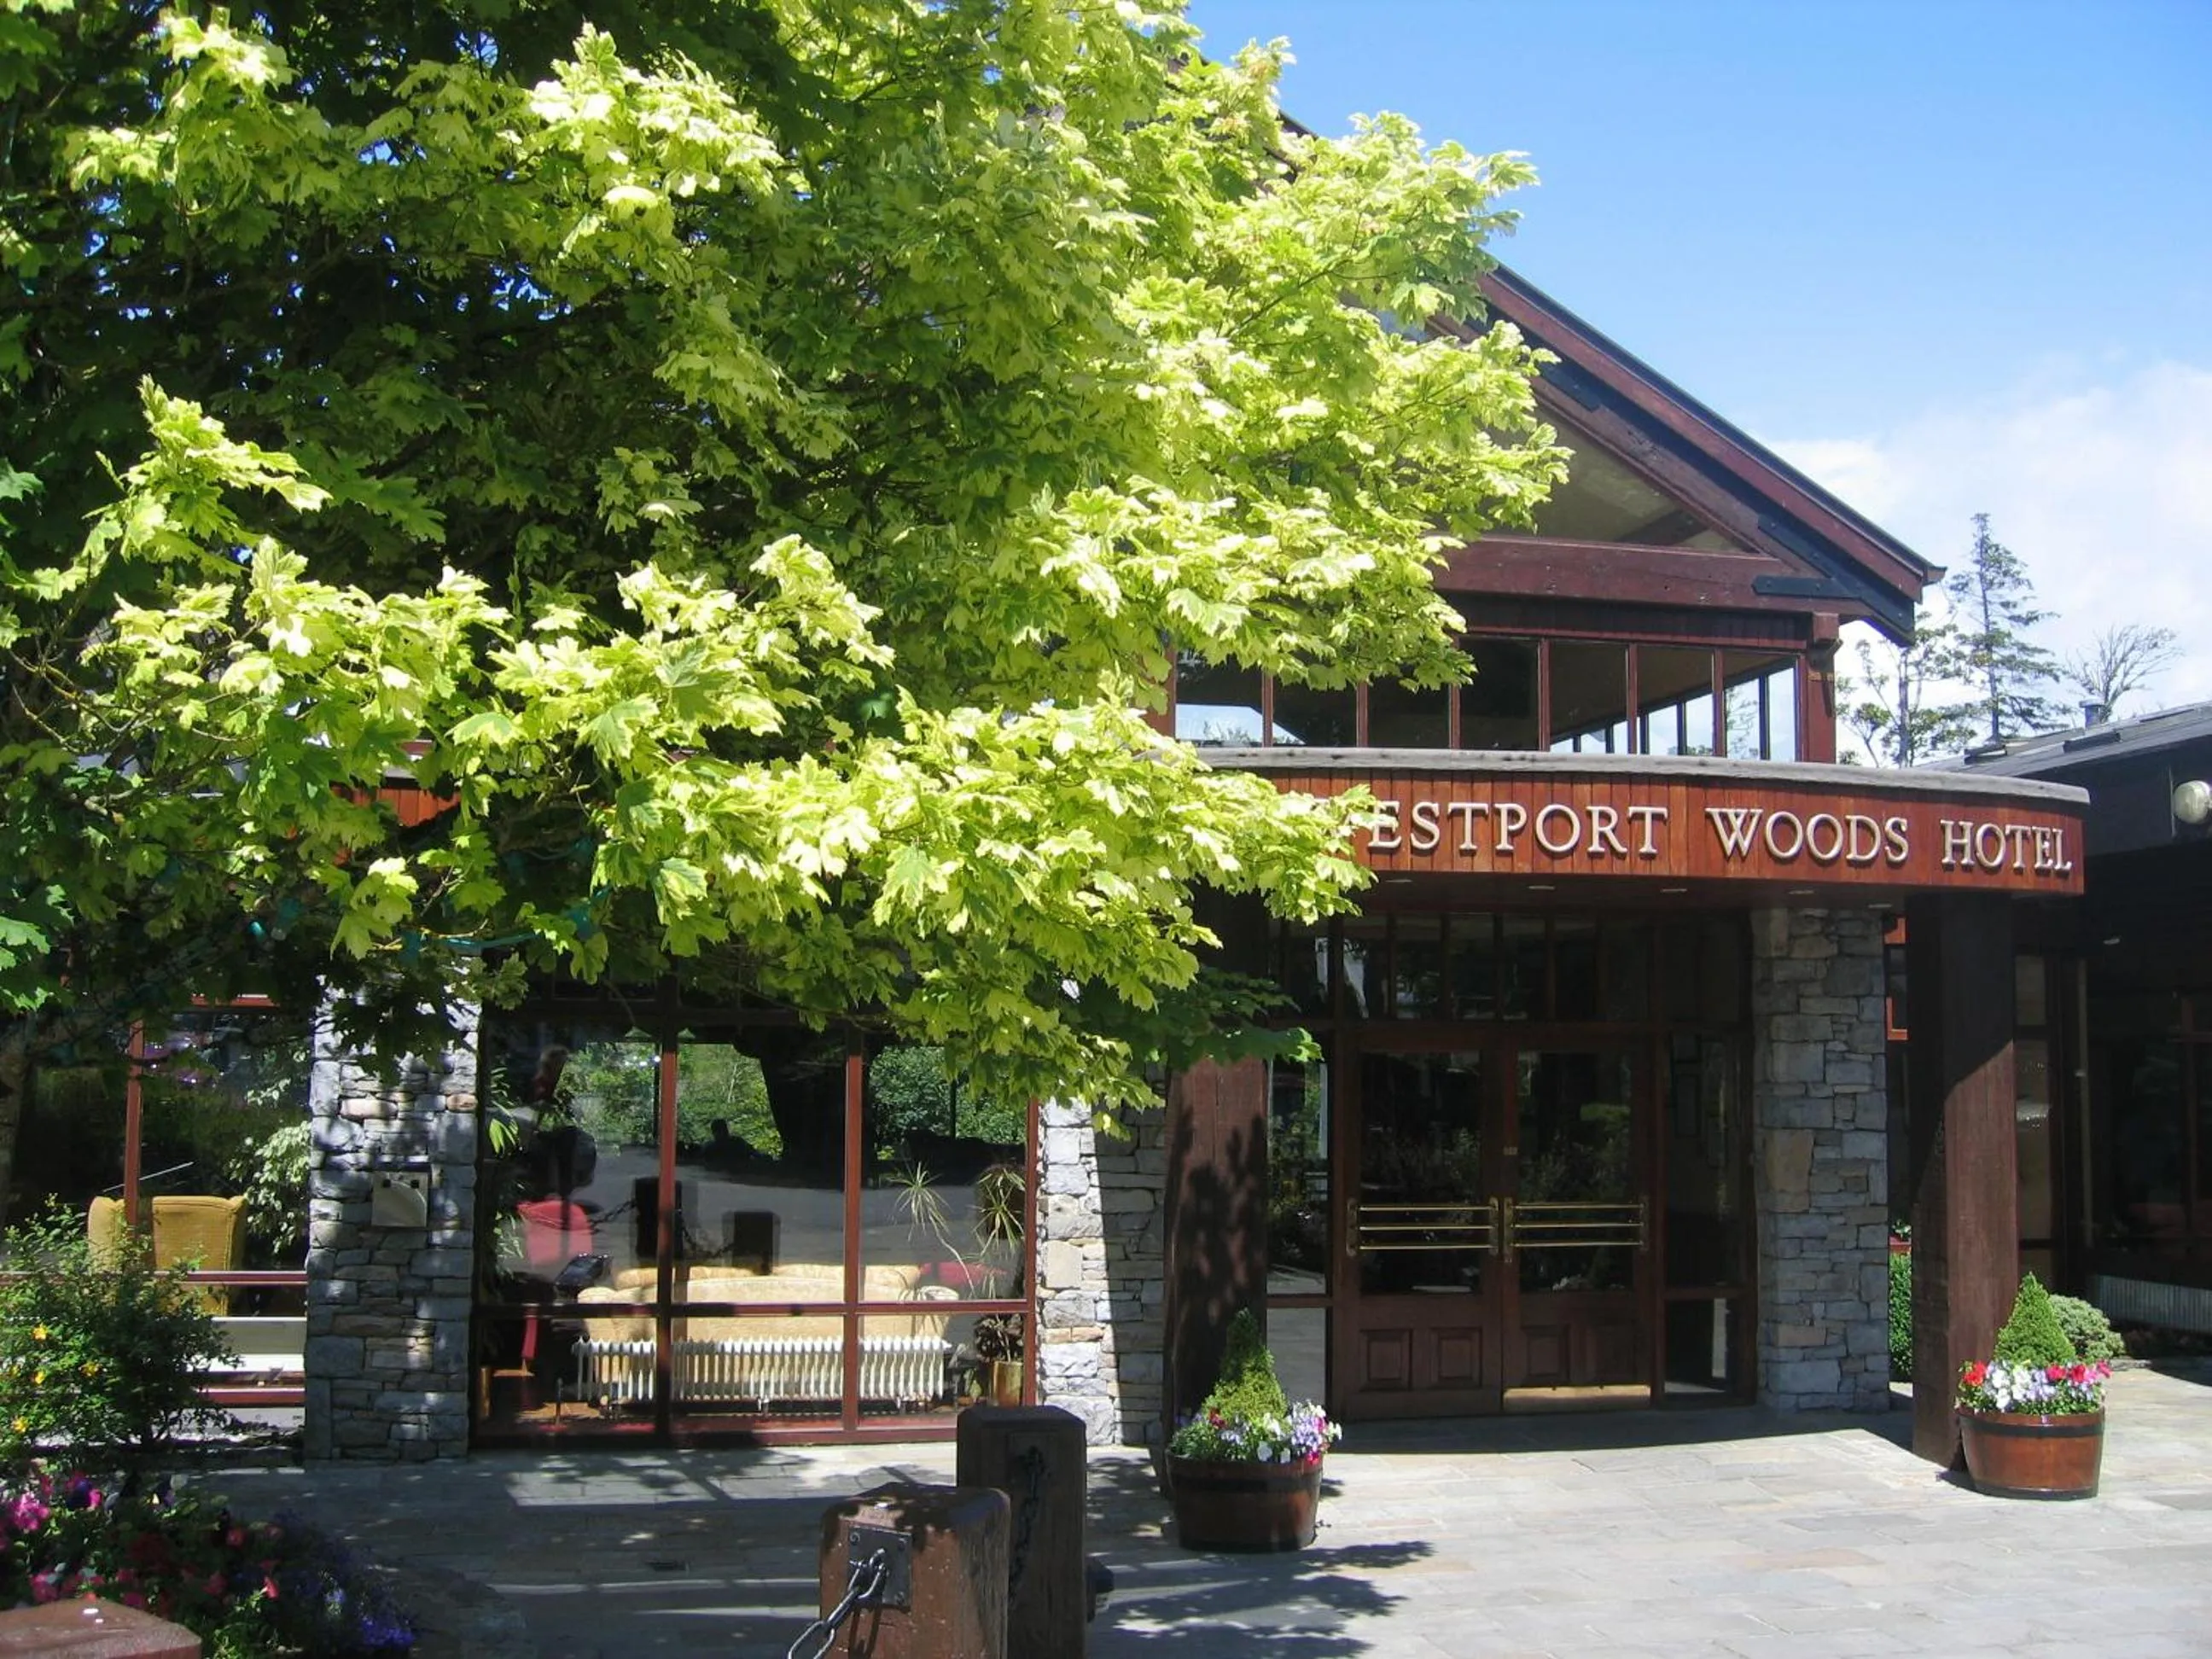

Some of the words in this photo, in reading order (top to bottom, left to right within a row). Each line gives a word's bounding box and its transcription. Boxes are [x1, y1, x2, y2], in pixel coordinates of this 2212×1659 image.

[1314, 799, 1668, 854] ESTPORT
[1705, 806, 1909, 863] WOODS
[1940, 818, 2073, 871] HOTEL
